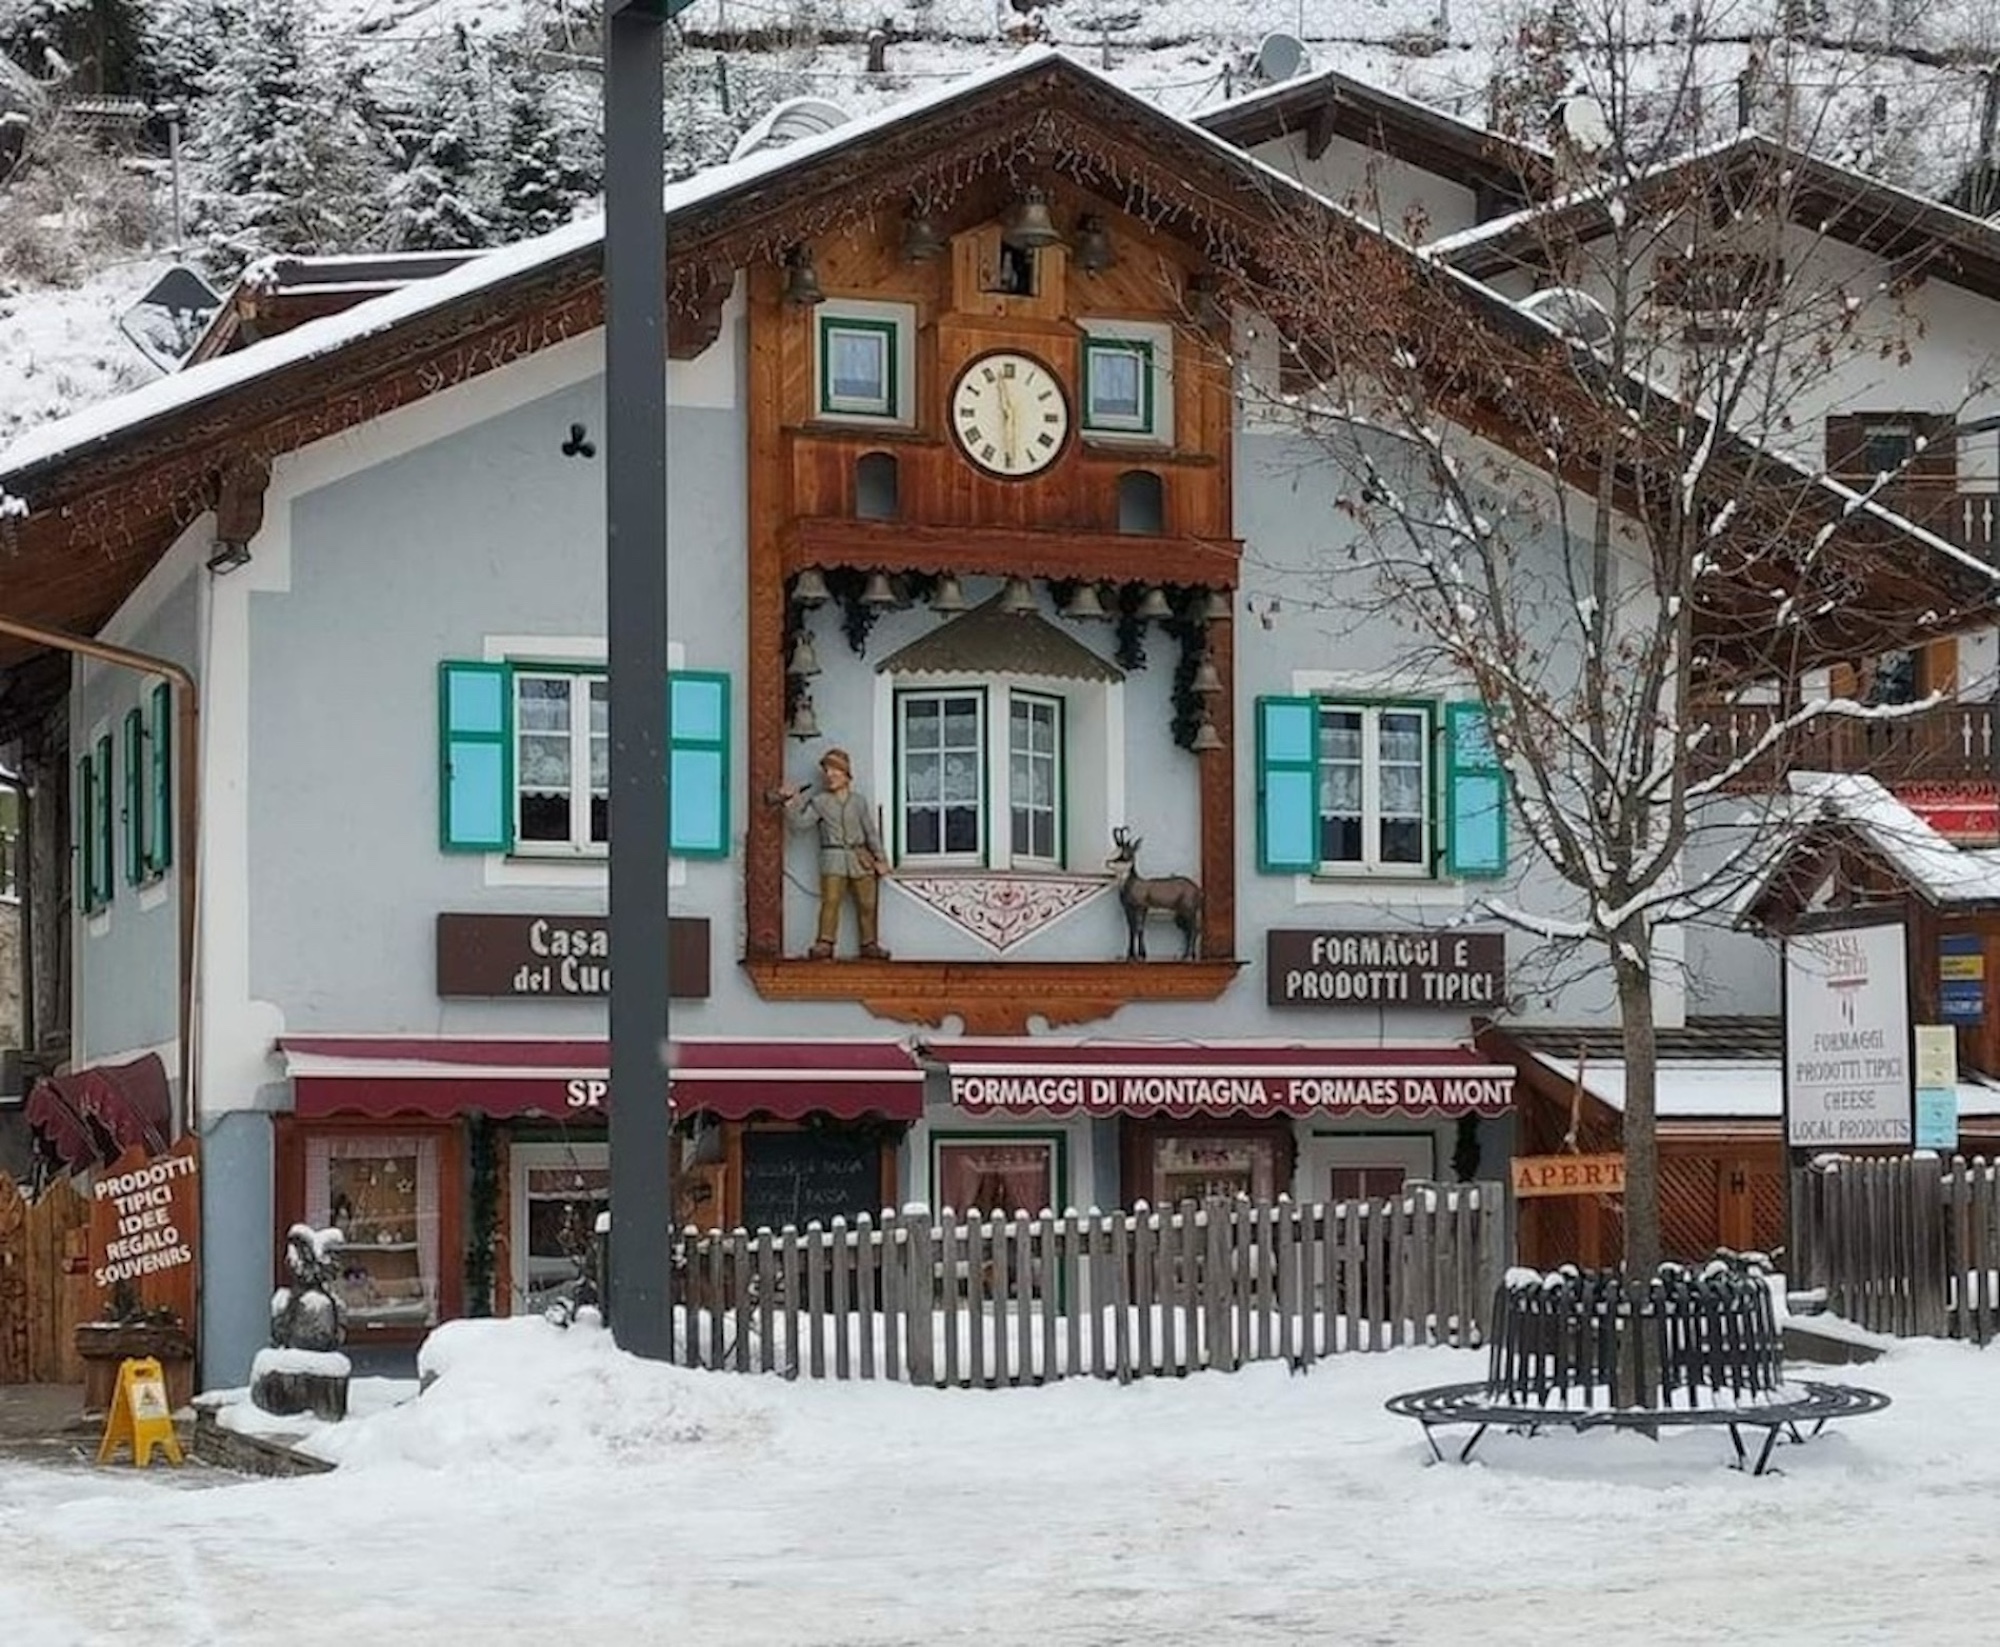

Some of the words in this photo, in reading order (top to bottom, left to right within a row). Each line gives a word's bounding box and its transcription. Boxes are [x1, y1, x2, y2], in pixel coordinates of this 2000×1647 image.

[530, 918, 609, 956] Casa
[1311, 936, 1439, 966] FORMAGGI
[1454, 939, 1469, 967] E
[513, 965, 550, 991] del
[1286, 970, 1408, 999] PRODOTTI
[1421, 972, 1493, 1000] TIPICI
[1813, 1029, 1883, 1052] FORMAGGI
[1796, 1060, 1860, 1081] PRODOTTI
[1864, 1058, 1902, 1078] TIPICI
[952, 1078, 1084, 1105] FORMAGGI
[1091, 1079, 1117, 1105] DI
[1122, 1079, 1268, 1105] MONTAGNA
[1288, 1079, 1398, 1105] FORMAES
[1404, 1079, 1437, 1105] DA
[1442, 1079, 1515, 1105] MONT
[1823, 1089, 1876, 1111] CHEESE
[1792, 1119, 1835, 1140] LOCAL
[1839, 1118, 1909, 1139] PRODUCTS
[94, 1155, 196, 1200] PRODOTTI
[1518, 1163, 1623, 1188] APERT
[113, 1184, 172, 1216] TIPICI
[118, 1206, 171, 1236] IDEE
[106, 1226, 178, 1261] REGALO
[94, 1244, 192, 1287] SOUVENIRS
